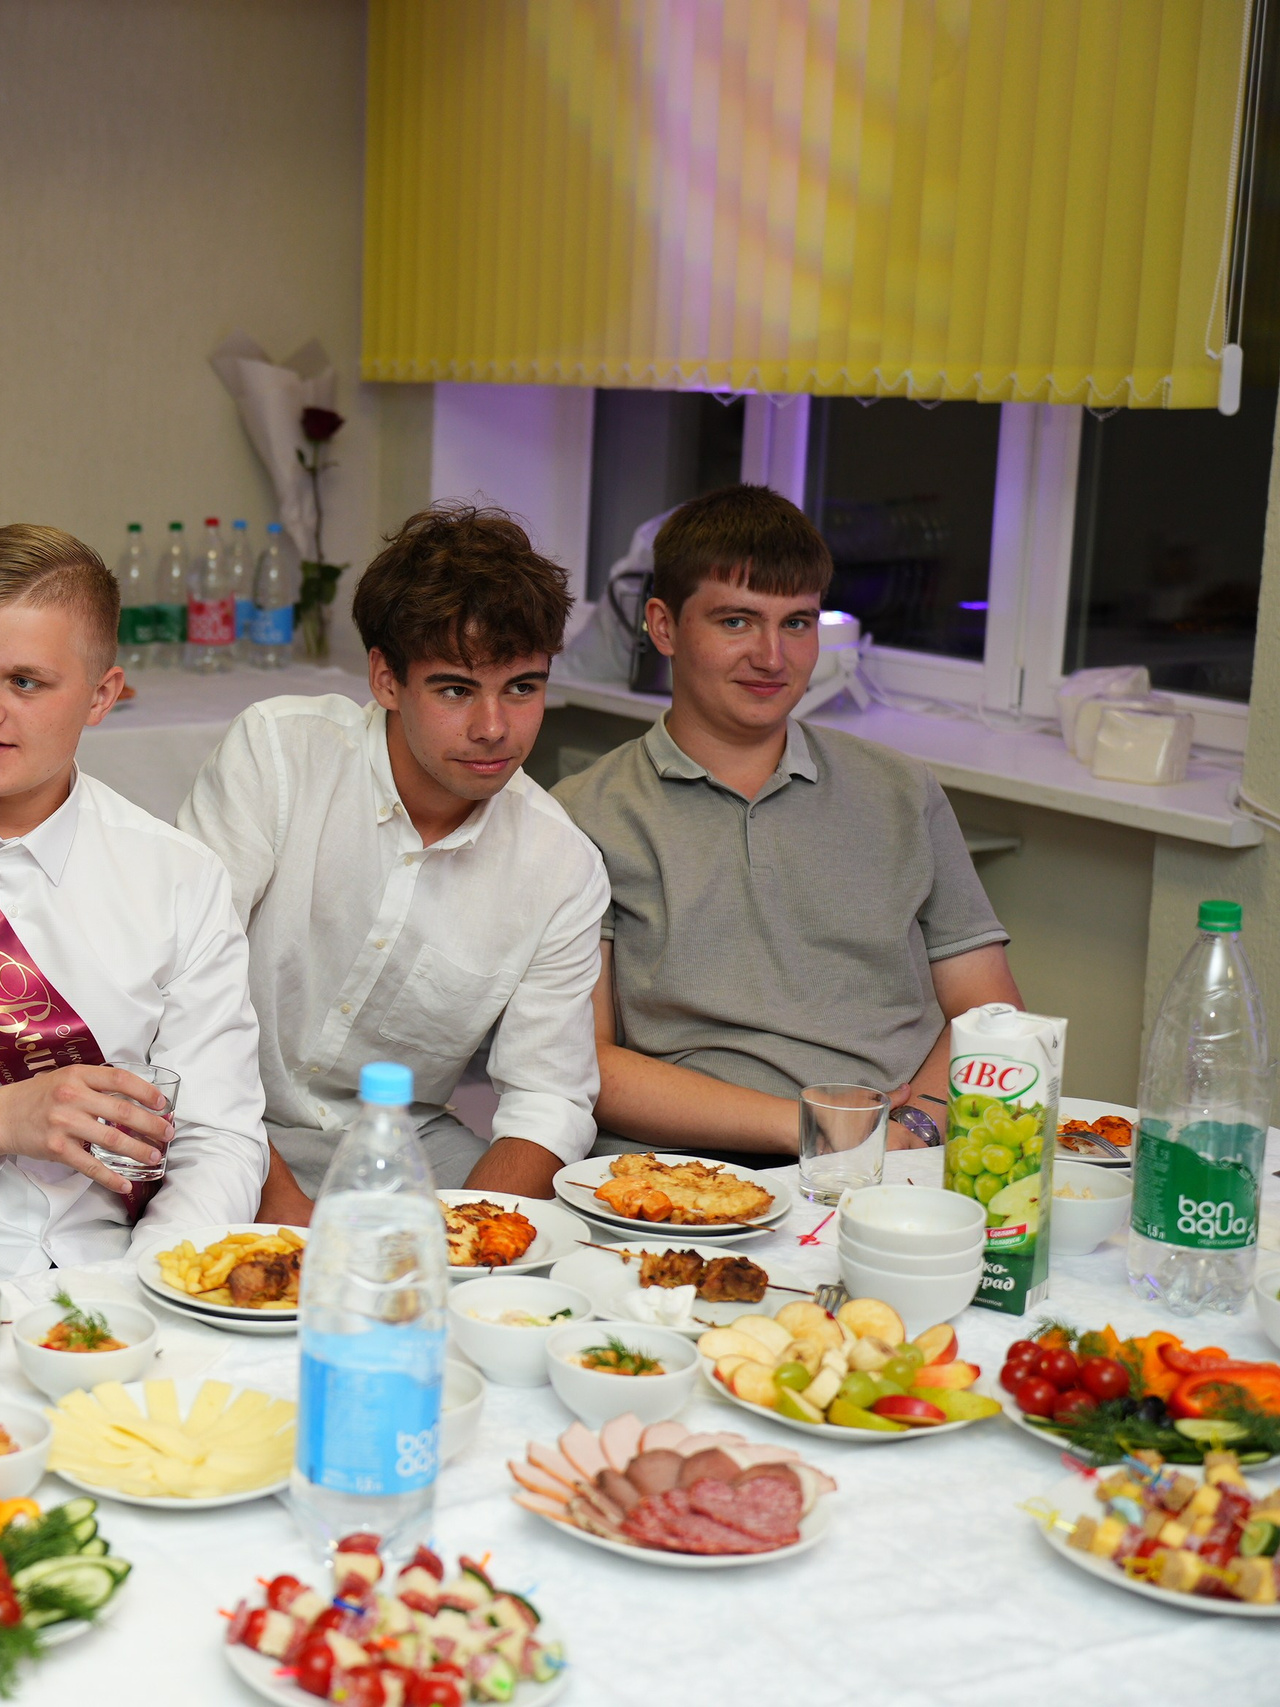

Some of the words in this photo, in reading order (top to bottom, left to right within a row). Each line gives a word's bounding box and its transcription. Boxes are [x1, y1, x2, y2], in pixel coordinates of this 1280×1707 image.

[55, 1024, 88, 1064] Лук
[952, 1060, 1023, 1092] ABC
[1178, 1194, 1235, 1218] bon
[1177, 1215, 1248, 1239] aqua
